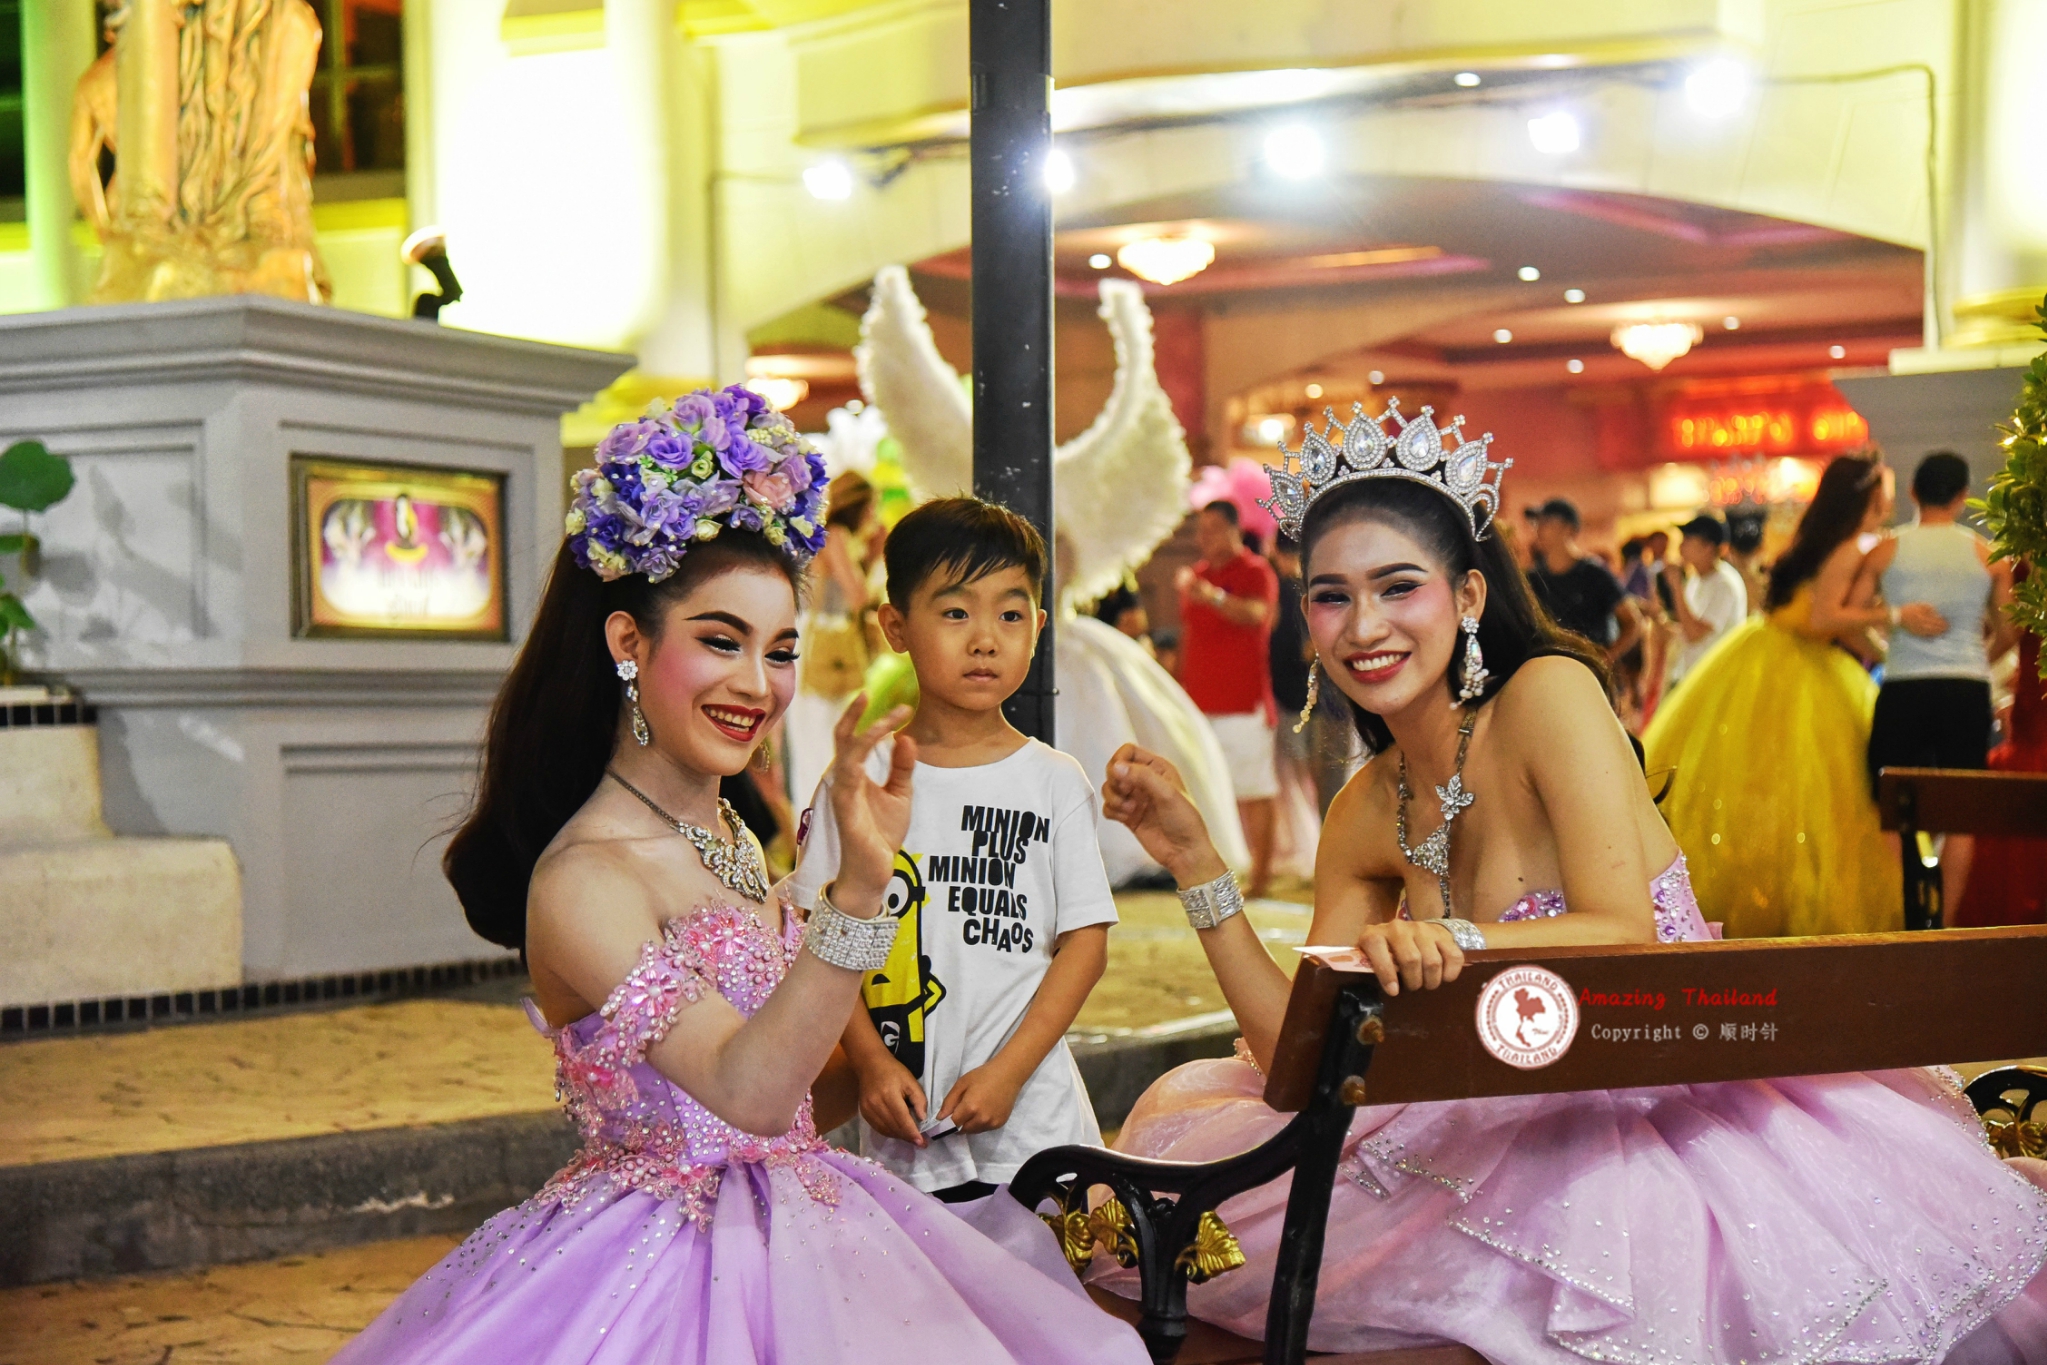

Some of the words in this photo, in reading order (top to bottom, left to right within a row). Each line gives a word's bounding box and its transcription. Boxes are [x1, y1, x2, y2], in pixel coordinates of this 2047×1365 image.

[961, 805, 1050, 843] MINION
[972, 830, 1029, 864] PLUS
[928, 855, 1016, 889] MINION
[948, 886, 1027, 921] EQUALS
[963, 917, 1034, 953] CHAOS
